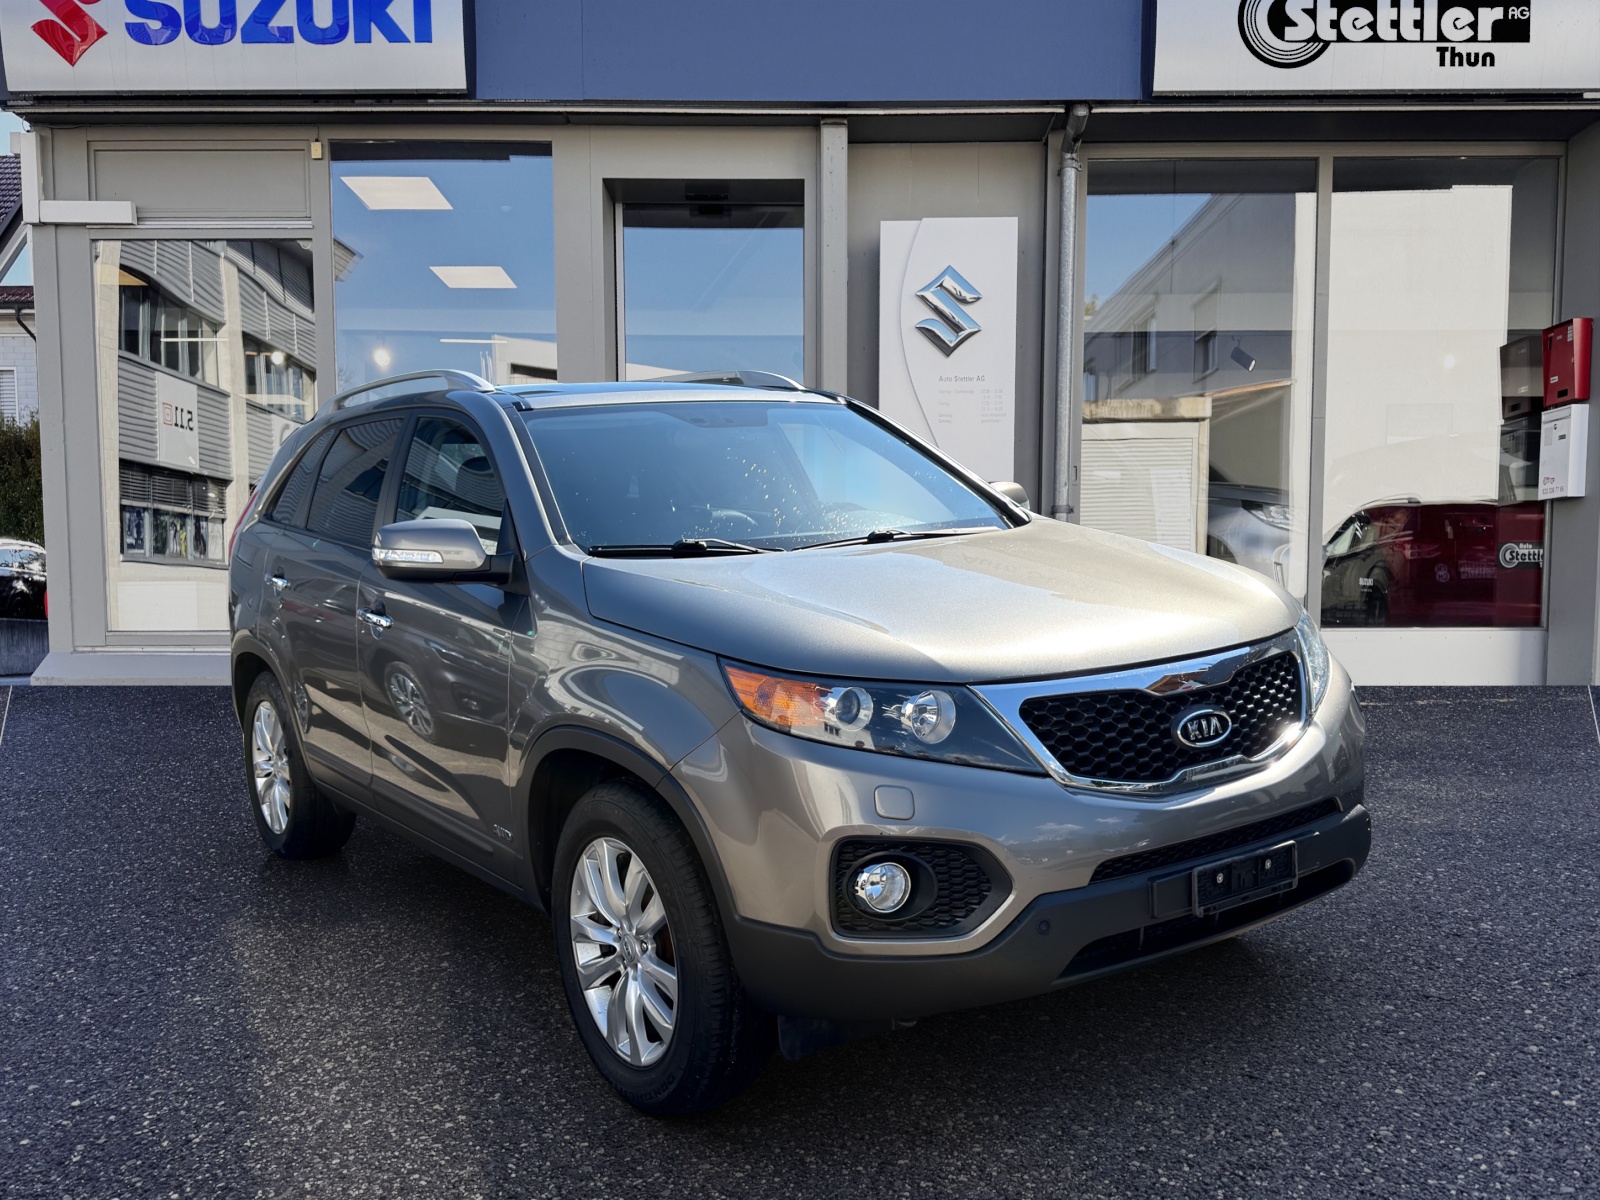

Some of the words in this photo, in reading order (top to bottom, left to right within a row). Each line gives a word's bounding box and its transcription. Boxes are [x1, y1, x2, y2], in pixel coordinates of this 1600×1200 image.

[124, 0, 433, 45] SUZUKI
[1283, 0, 1504, 42] Stettler
[1508, 6, 1530, 20] AG
[1436, 46, 1495, 67] Thun
[1187, 716, 1223, 741] KIA
